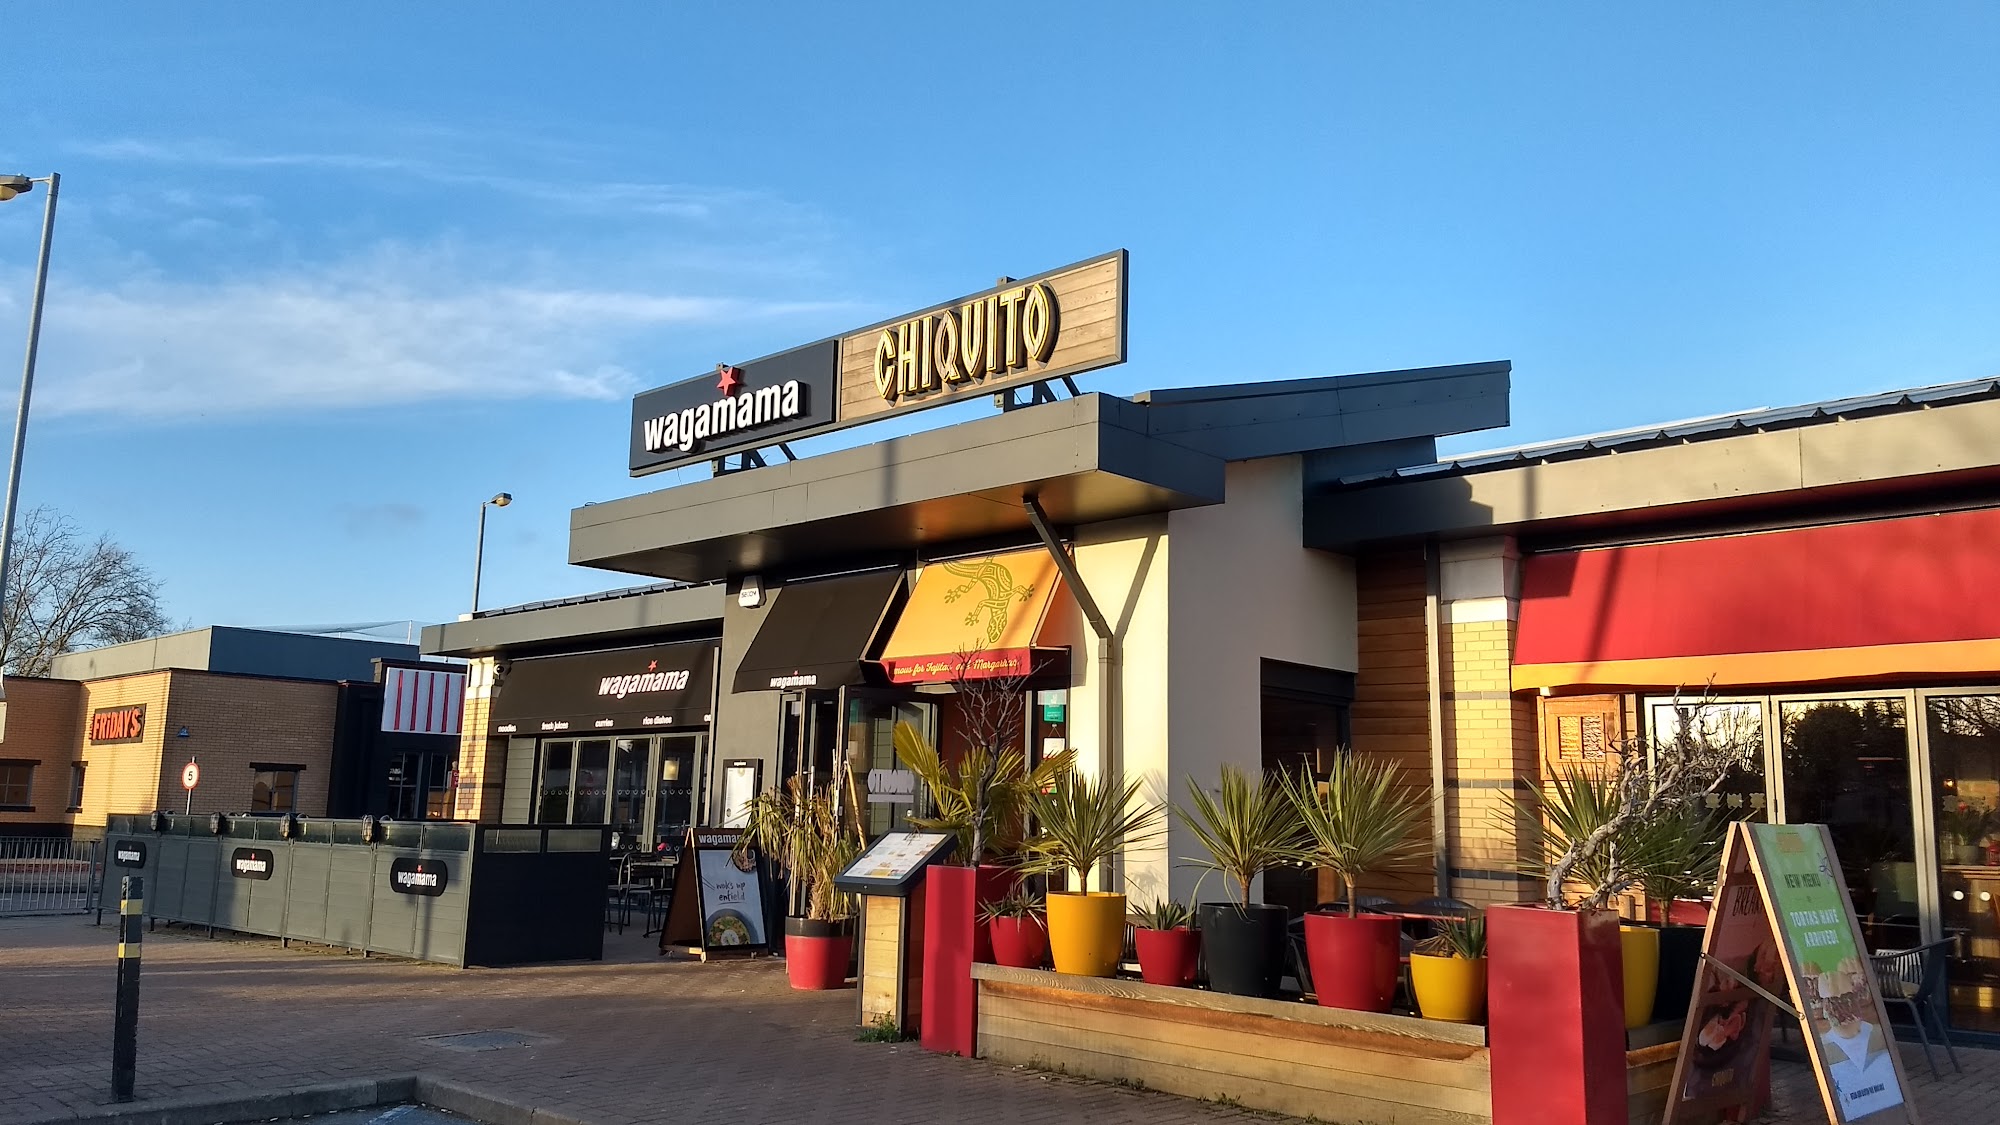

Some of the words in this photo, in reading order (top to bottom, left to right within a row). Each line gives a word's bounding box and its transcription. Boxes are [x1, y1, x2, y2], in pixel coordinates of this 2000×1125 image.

[873, 282, 1054, 400] CHIQUITO
[643, 379, 799, 453] wagamama
[598, 670, 690, 699] wagamama
[770, 675, 817, 689] wagamama
[187, 771, 193, 781] 5
[397, 871, 438, 888] wagamama
[1784, 873, 1801, 888] NEW
[1801, 873, 1821, 888] MENU
